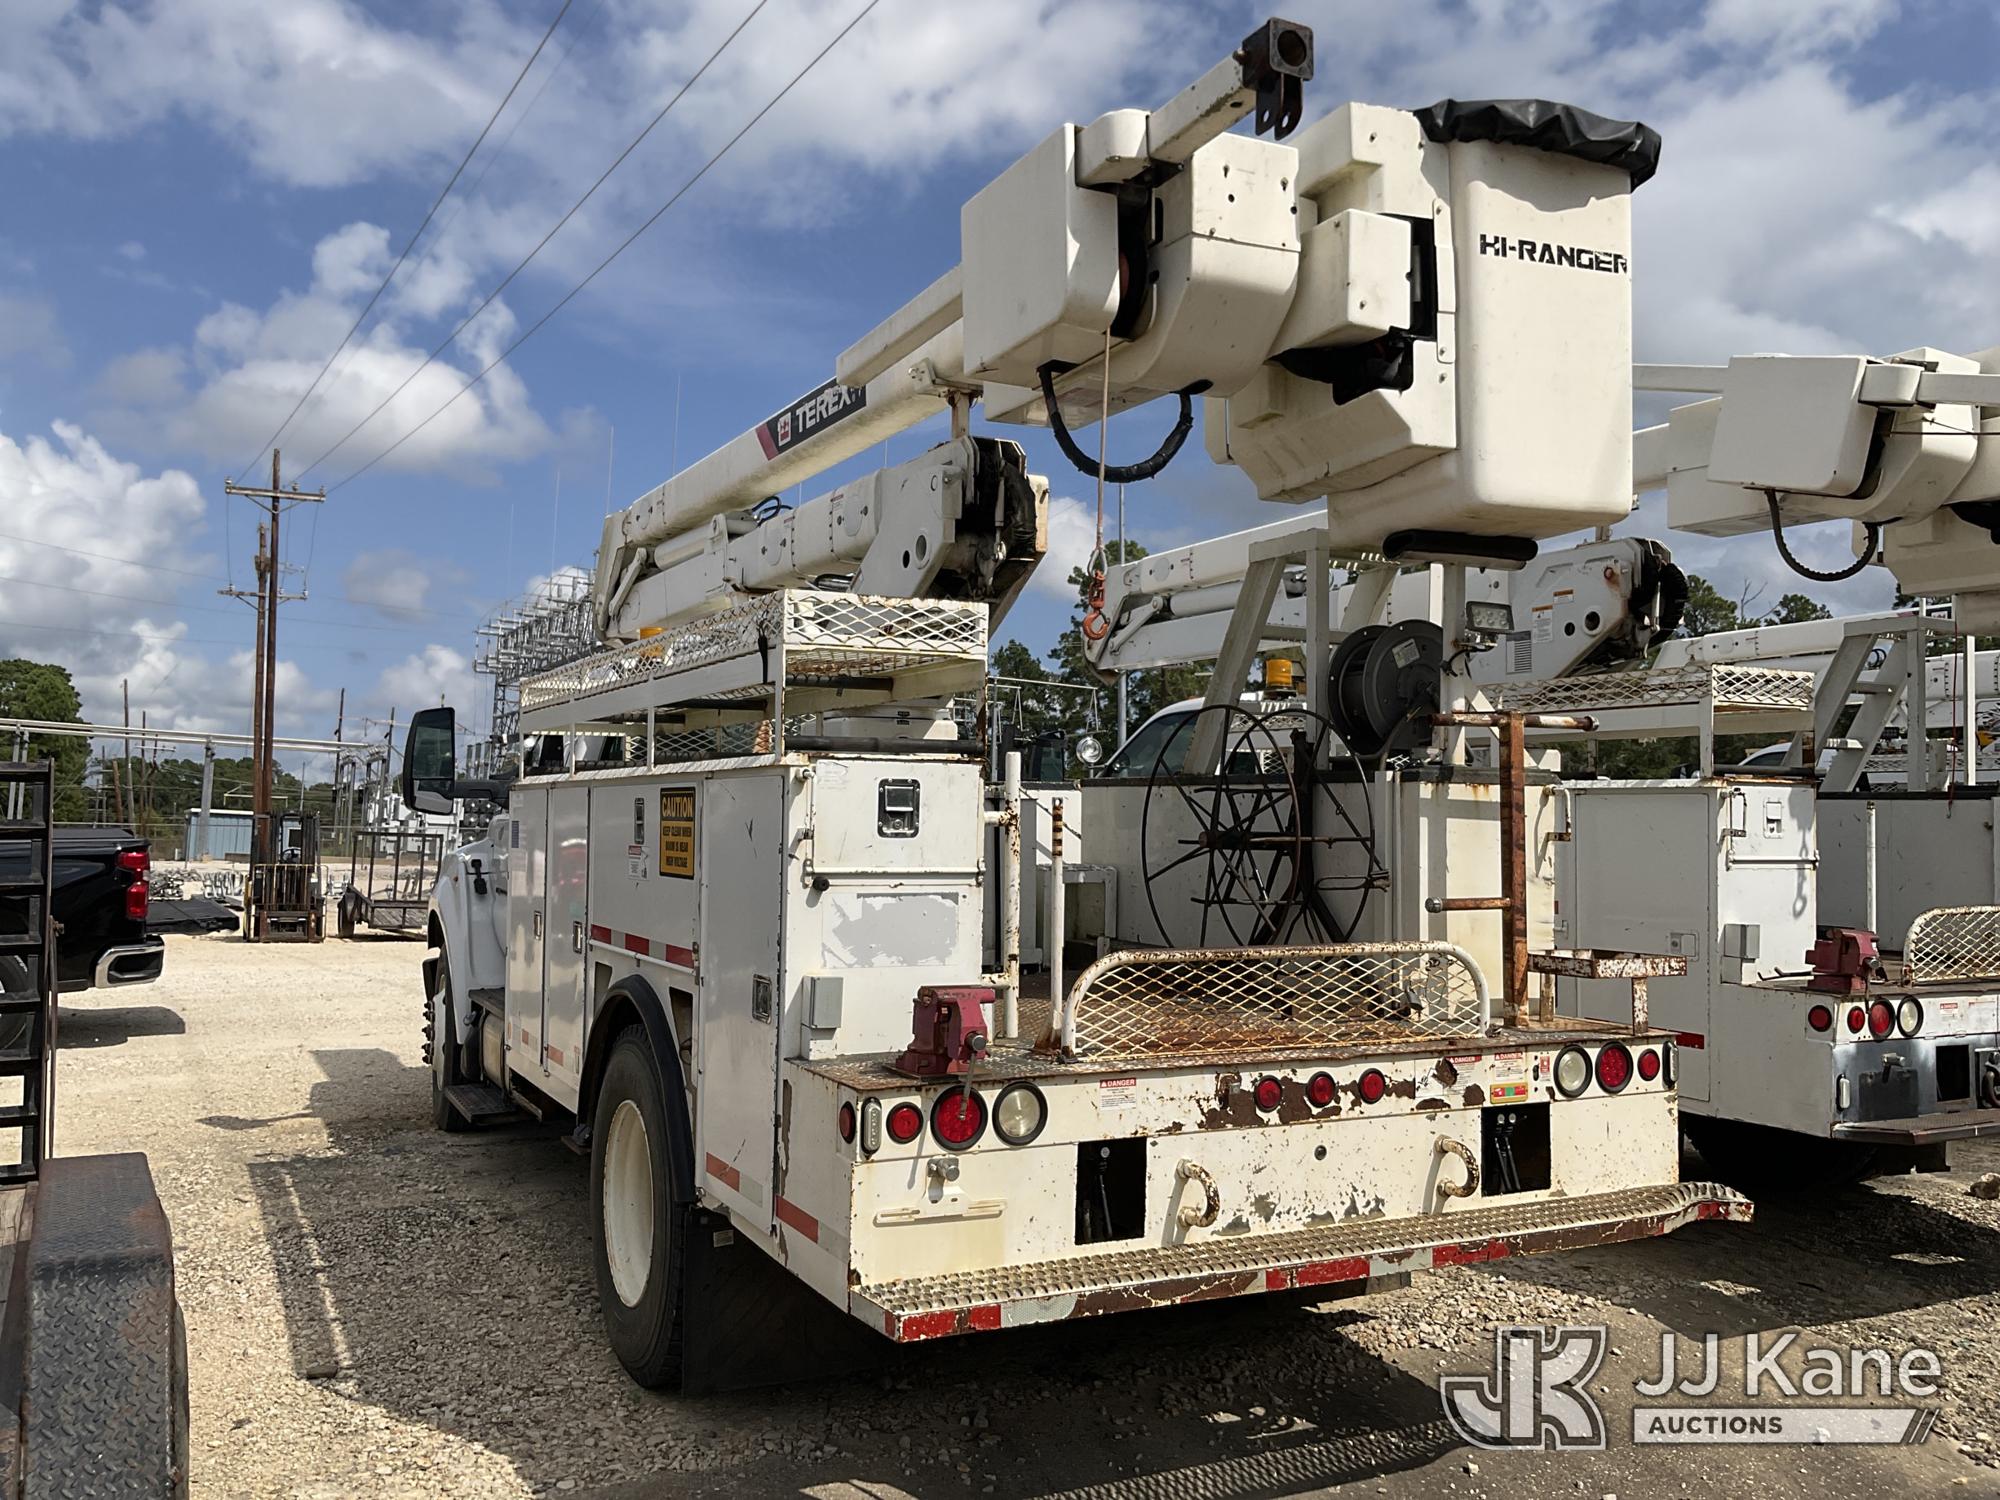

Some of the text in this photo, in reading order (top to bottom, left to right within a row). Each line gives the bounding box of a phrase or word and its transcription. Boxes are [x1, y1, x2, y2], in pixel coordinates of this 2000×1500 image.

[1480, 233, 1628, 274] HI-RANGER
[795, 384, 852, 433] TEREX
[662, 796, 693, 818] CAUTION
[1107, 1079, 1135, 1087] DANGER
